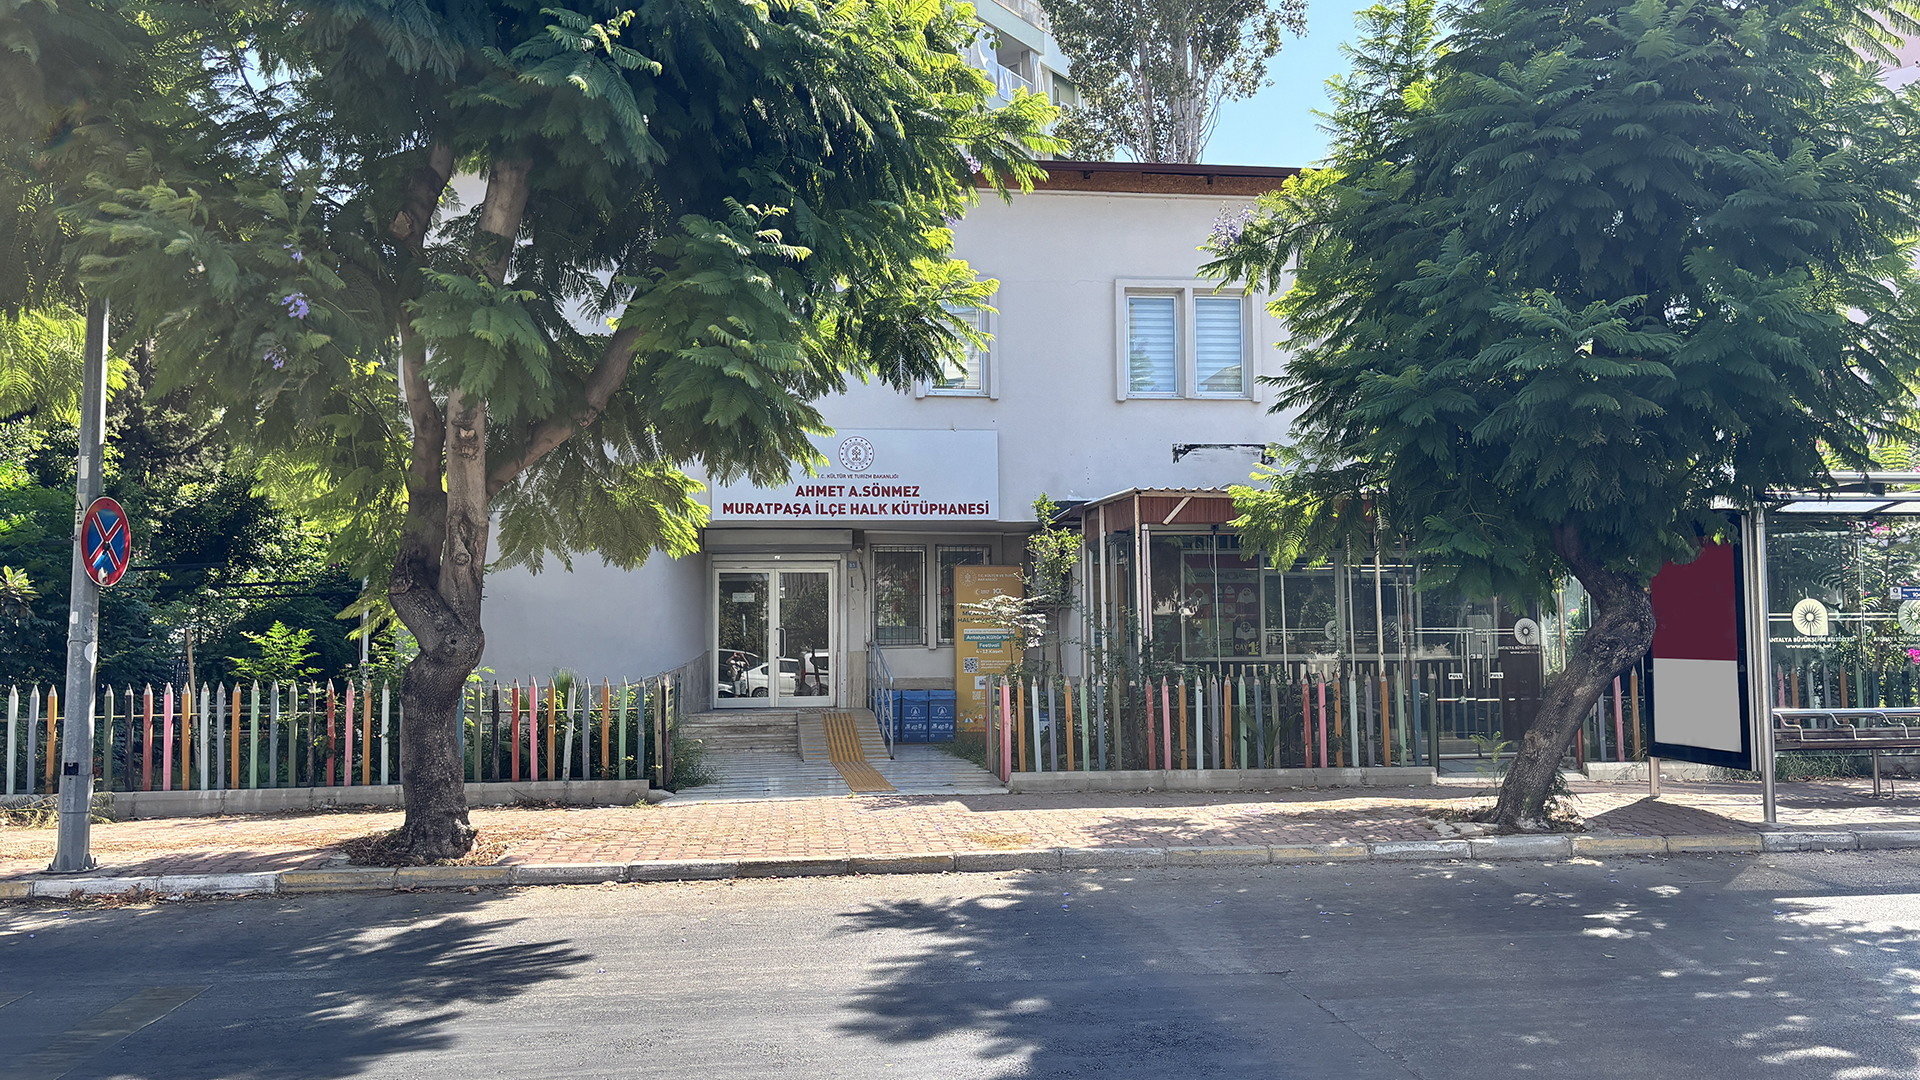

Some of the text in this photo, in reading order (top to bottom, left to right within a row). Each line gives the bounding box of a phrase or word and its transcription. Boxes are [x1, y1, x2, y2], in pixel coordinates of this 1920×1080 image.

[795, 482, 920, 497] AHMET A.SÖNMEZ
[722, 500, 989, 517] MURATPAŞA İLÇE HALK KÜTÜPHANESİ
